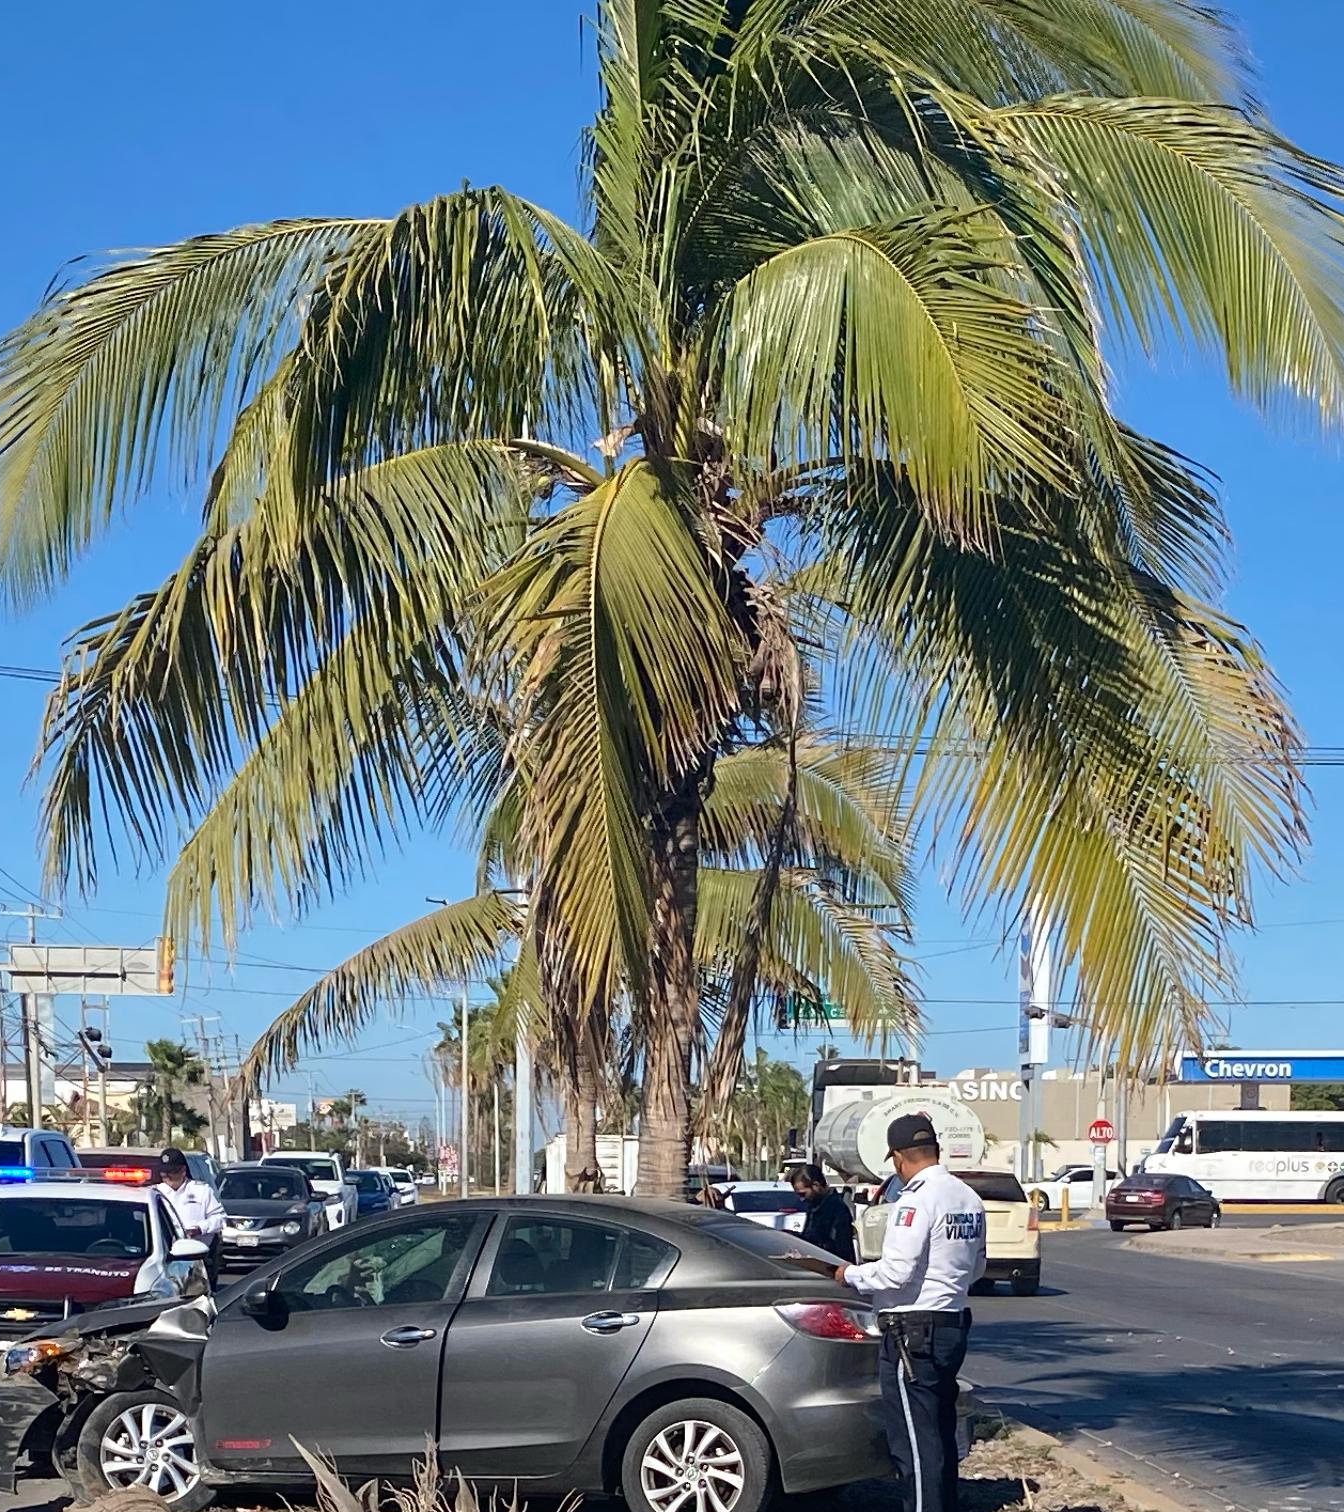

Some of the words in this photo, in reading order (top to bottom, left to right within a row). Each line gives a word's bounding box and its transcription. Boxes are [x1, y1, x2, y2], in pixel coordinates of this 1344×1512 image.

[1206, 1059, 1292, 1078] Chevron
[1089, 1126, 1113, 1139] ALTO
[1248, 1158, 1310, 1176] redplus
